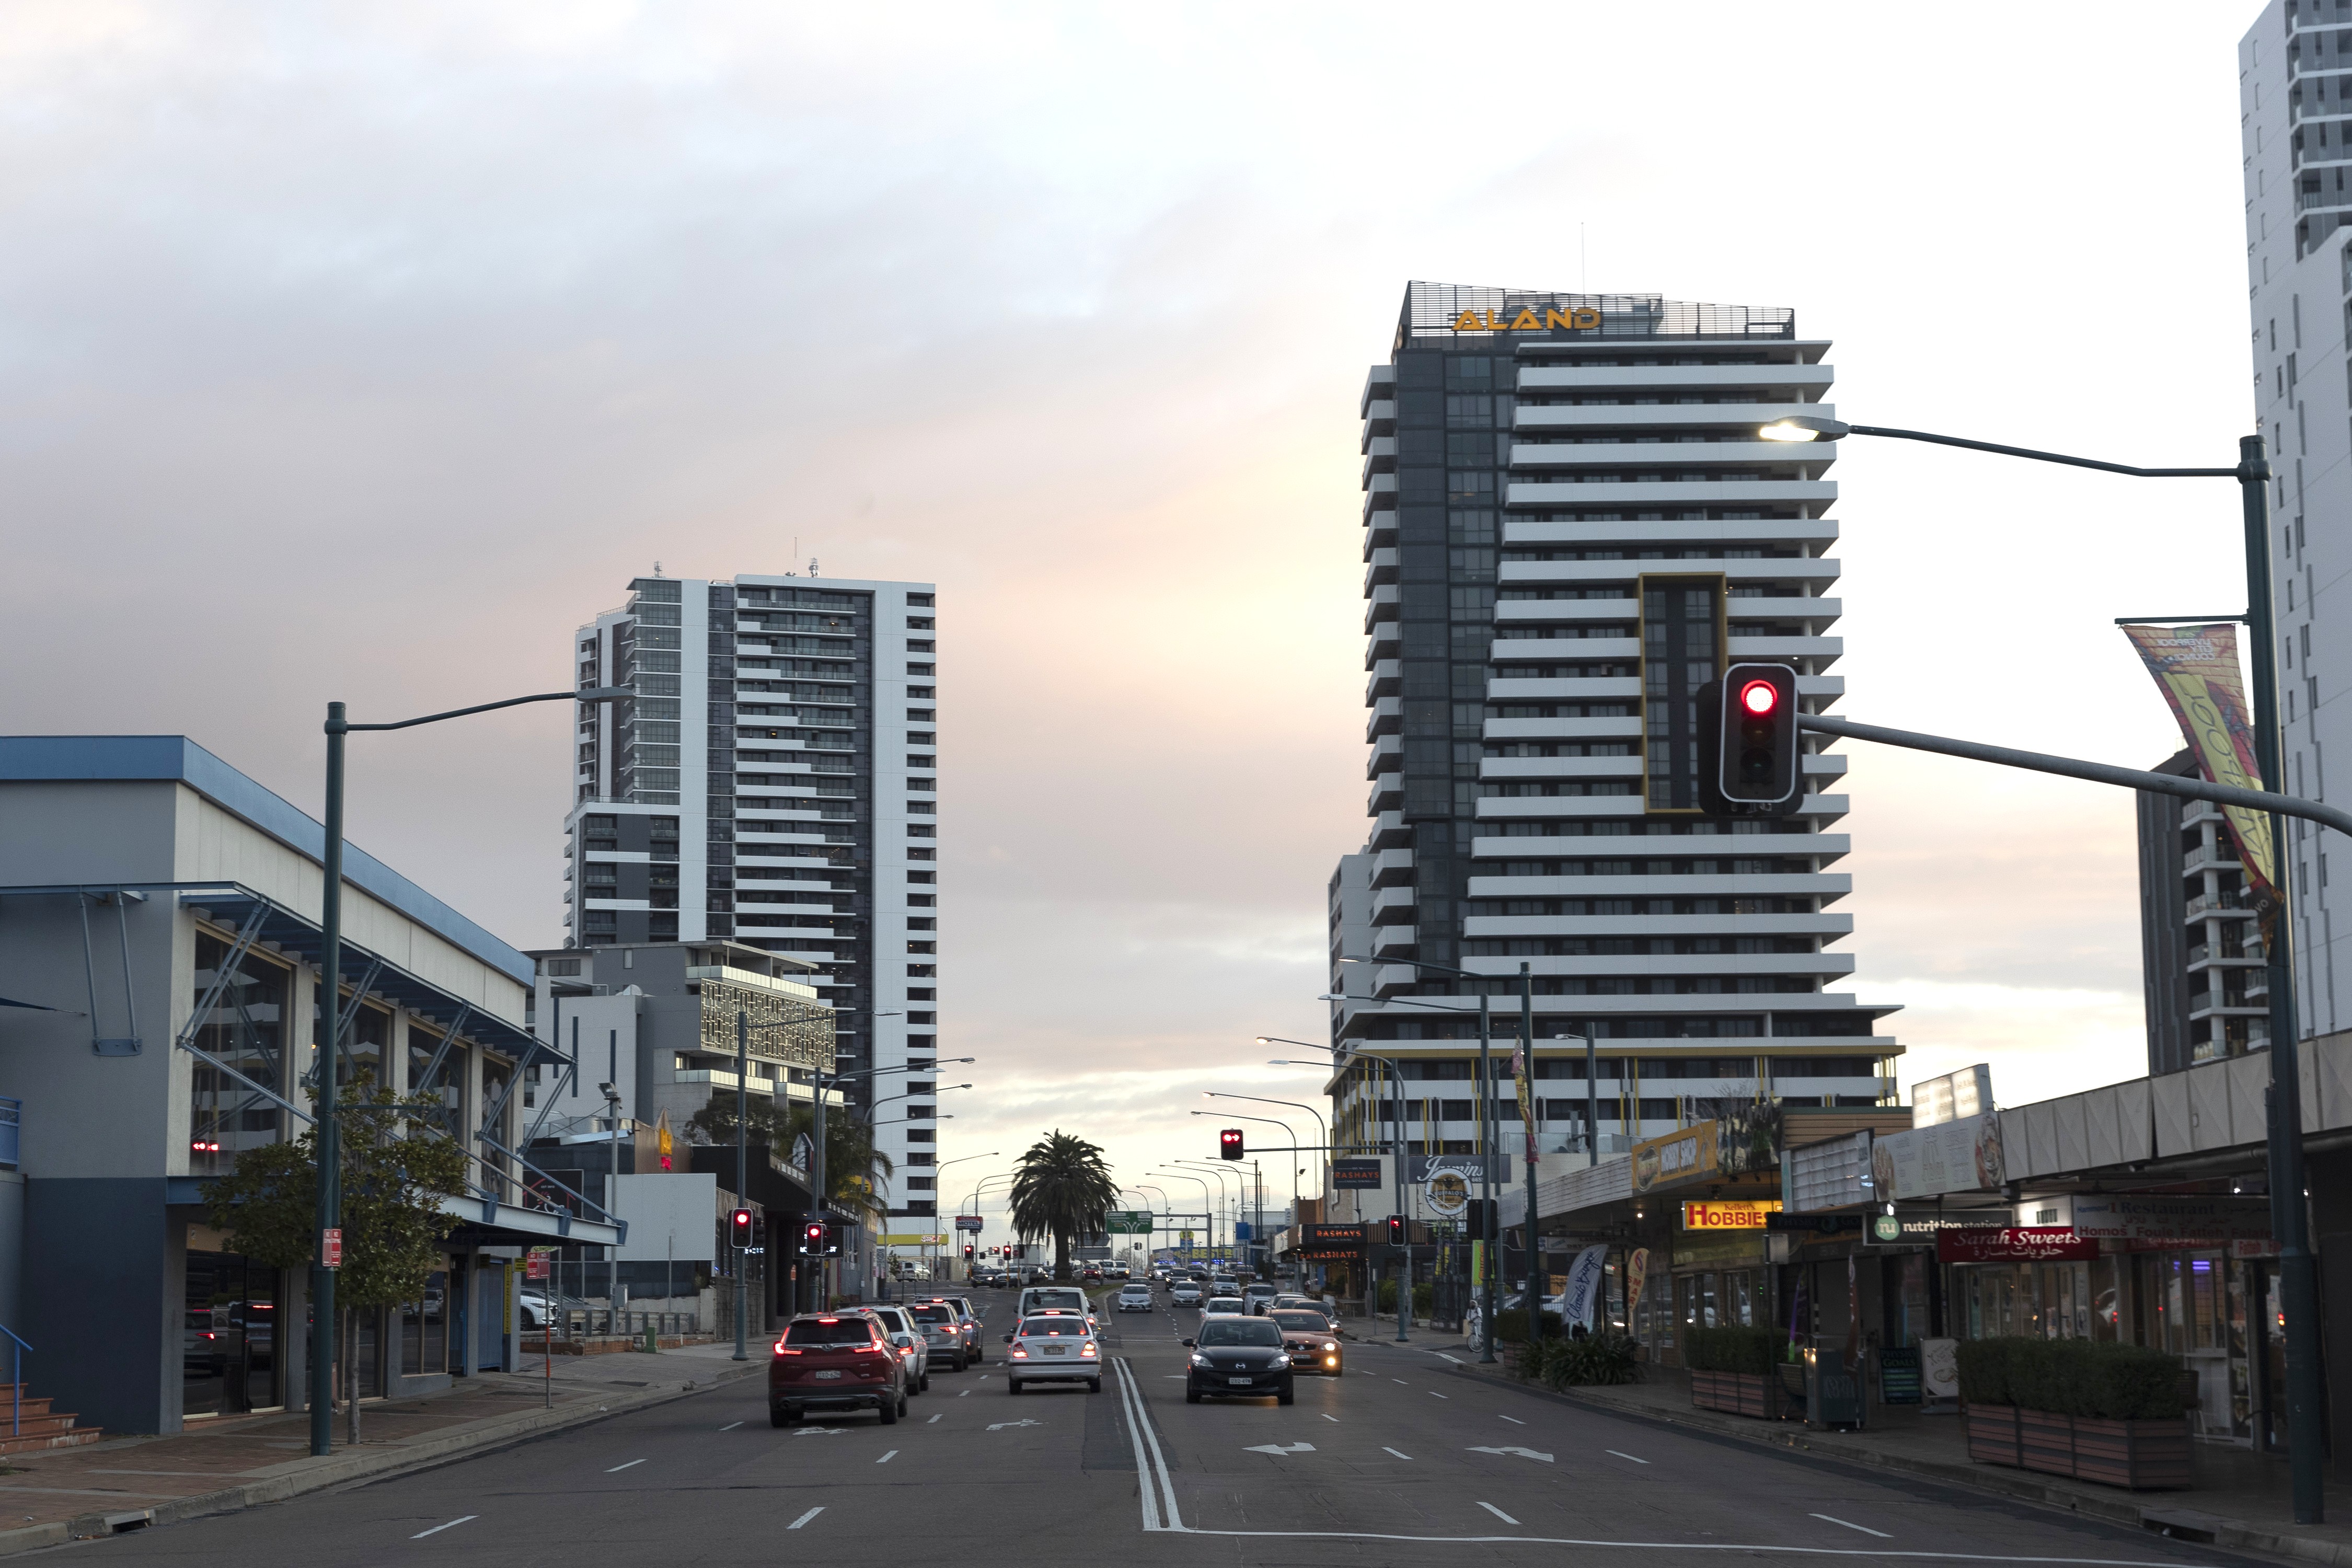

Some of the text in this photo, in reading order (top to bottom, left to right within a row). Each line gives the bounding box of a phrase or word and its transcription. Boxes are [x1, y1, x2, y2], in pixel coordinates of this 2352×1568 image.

[1451, 307, 1601, 330] ALAND
[2120, 1202, 2216, 1215] Restaurant
[1953, 1229, 2082, 1247] Sarah Sweets
[1566, 1285, 1586, 1319] Classic
